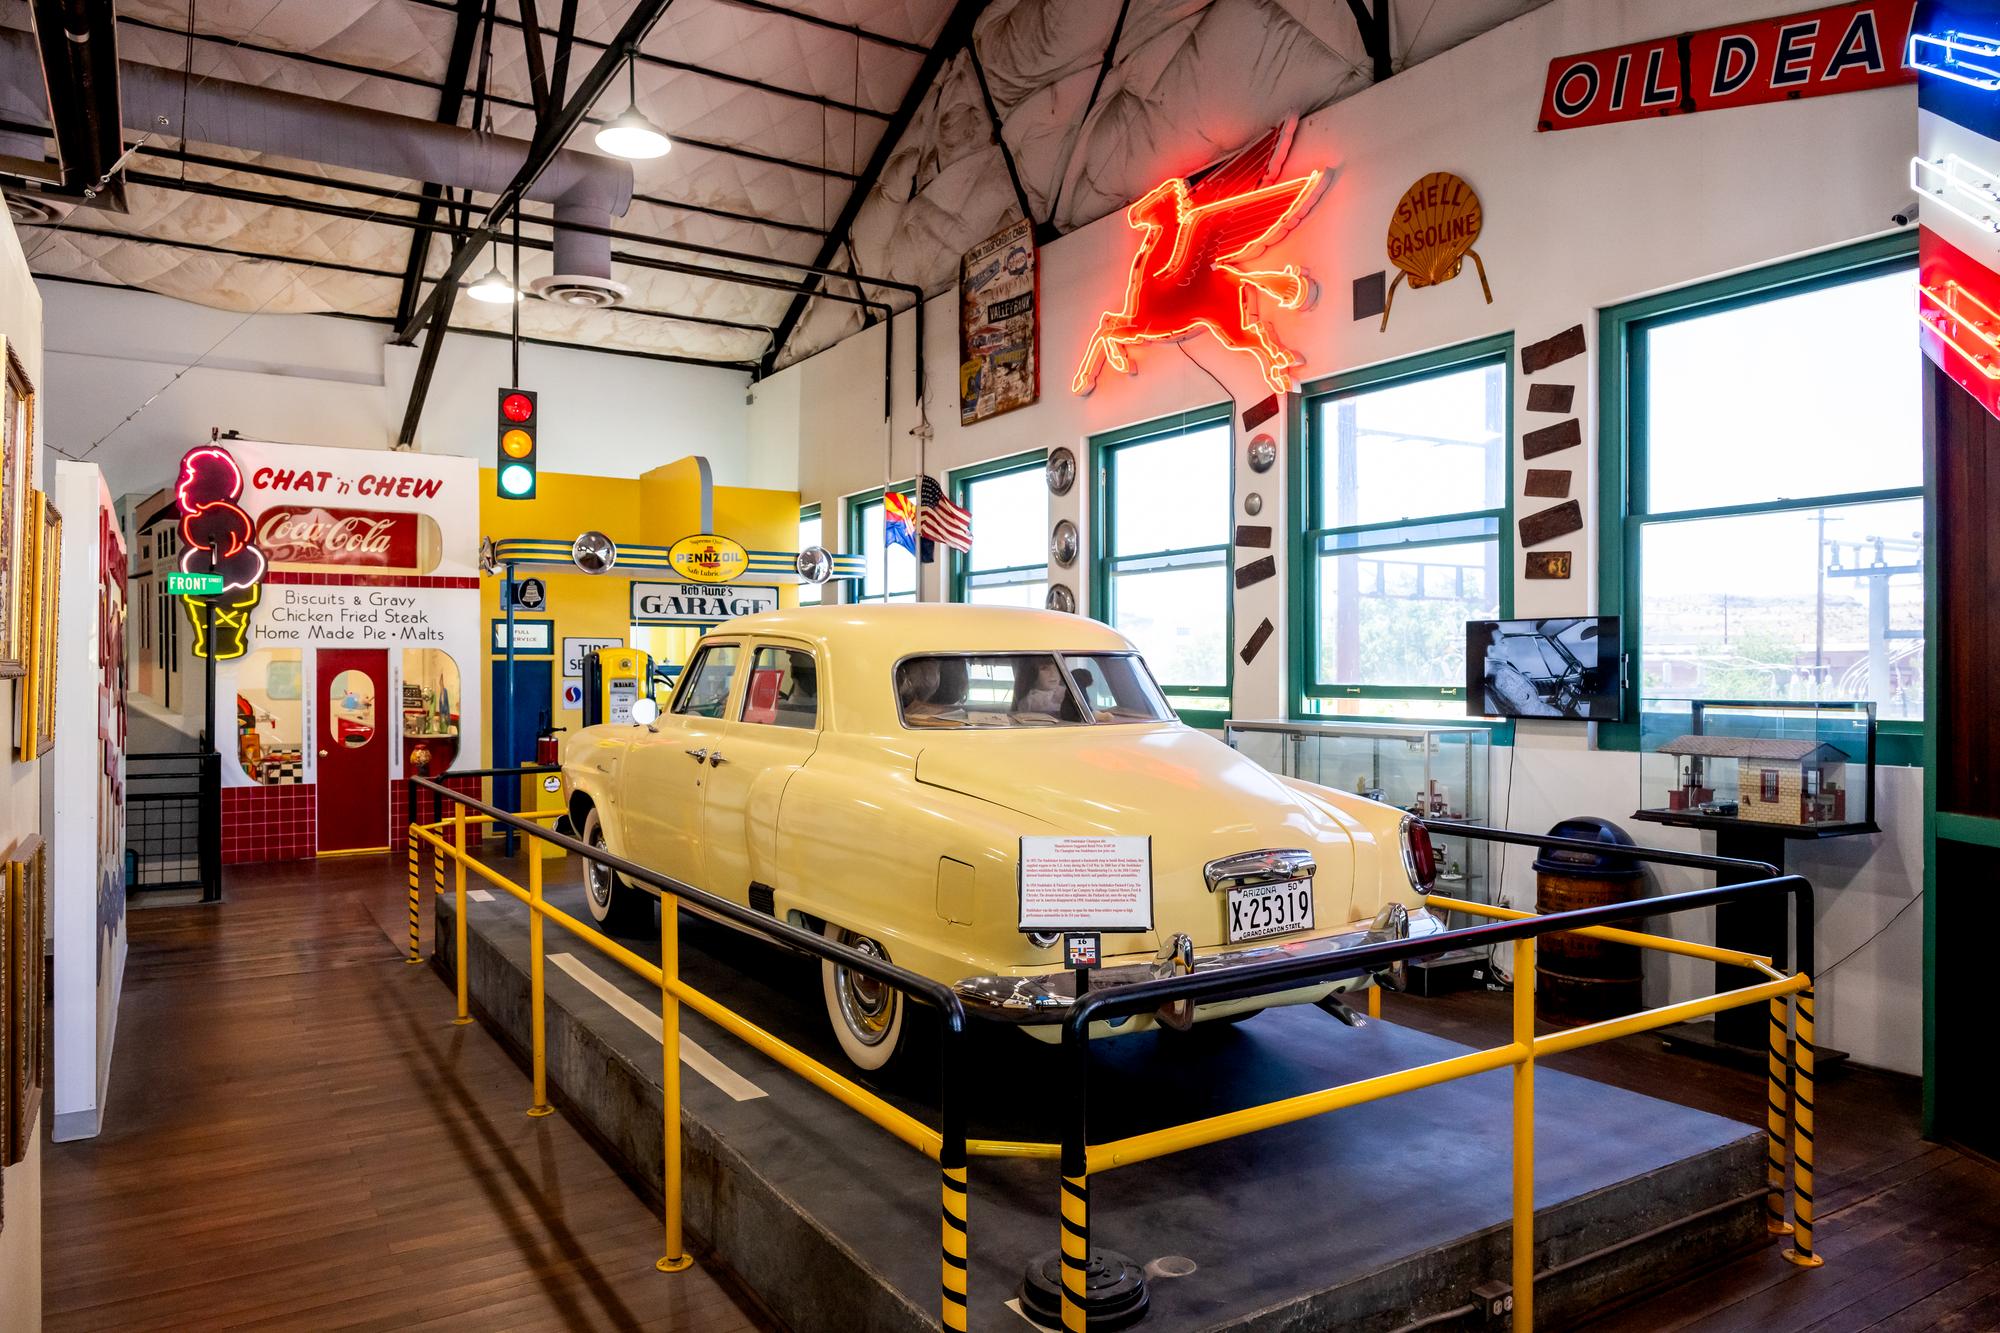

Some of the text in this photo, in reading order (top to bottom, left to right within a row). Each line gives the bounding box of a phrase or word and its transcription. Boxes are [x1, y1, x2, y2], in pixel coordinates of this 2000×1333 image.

[1553, 48, 1677, 118] OIL
[1399, 183, 1462, 223] SHELL
[1390, 212, 1476, 259] GASOLINE
[252, 467, 332, 492] CHAT
[358, 474, 443, 499] CHEW
[676, 552, 742, 563] PENNZOIL
[169, 576, 207, 590] FRONT
[680, 584, 734, 596] Bob Aune's
[285, 590, 416, 608] Biscuits & Gravy
[272, 608, 428, 624] Chicken Fried Steak
[254, 626, 444, 641] Home Made Pie Malts
[1242, 882, 1298, 898] ARIZONA 50
[1242, 922, 1301, 938] GRAND CANYON STATE
